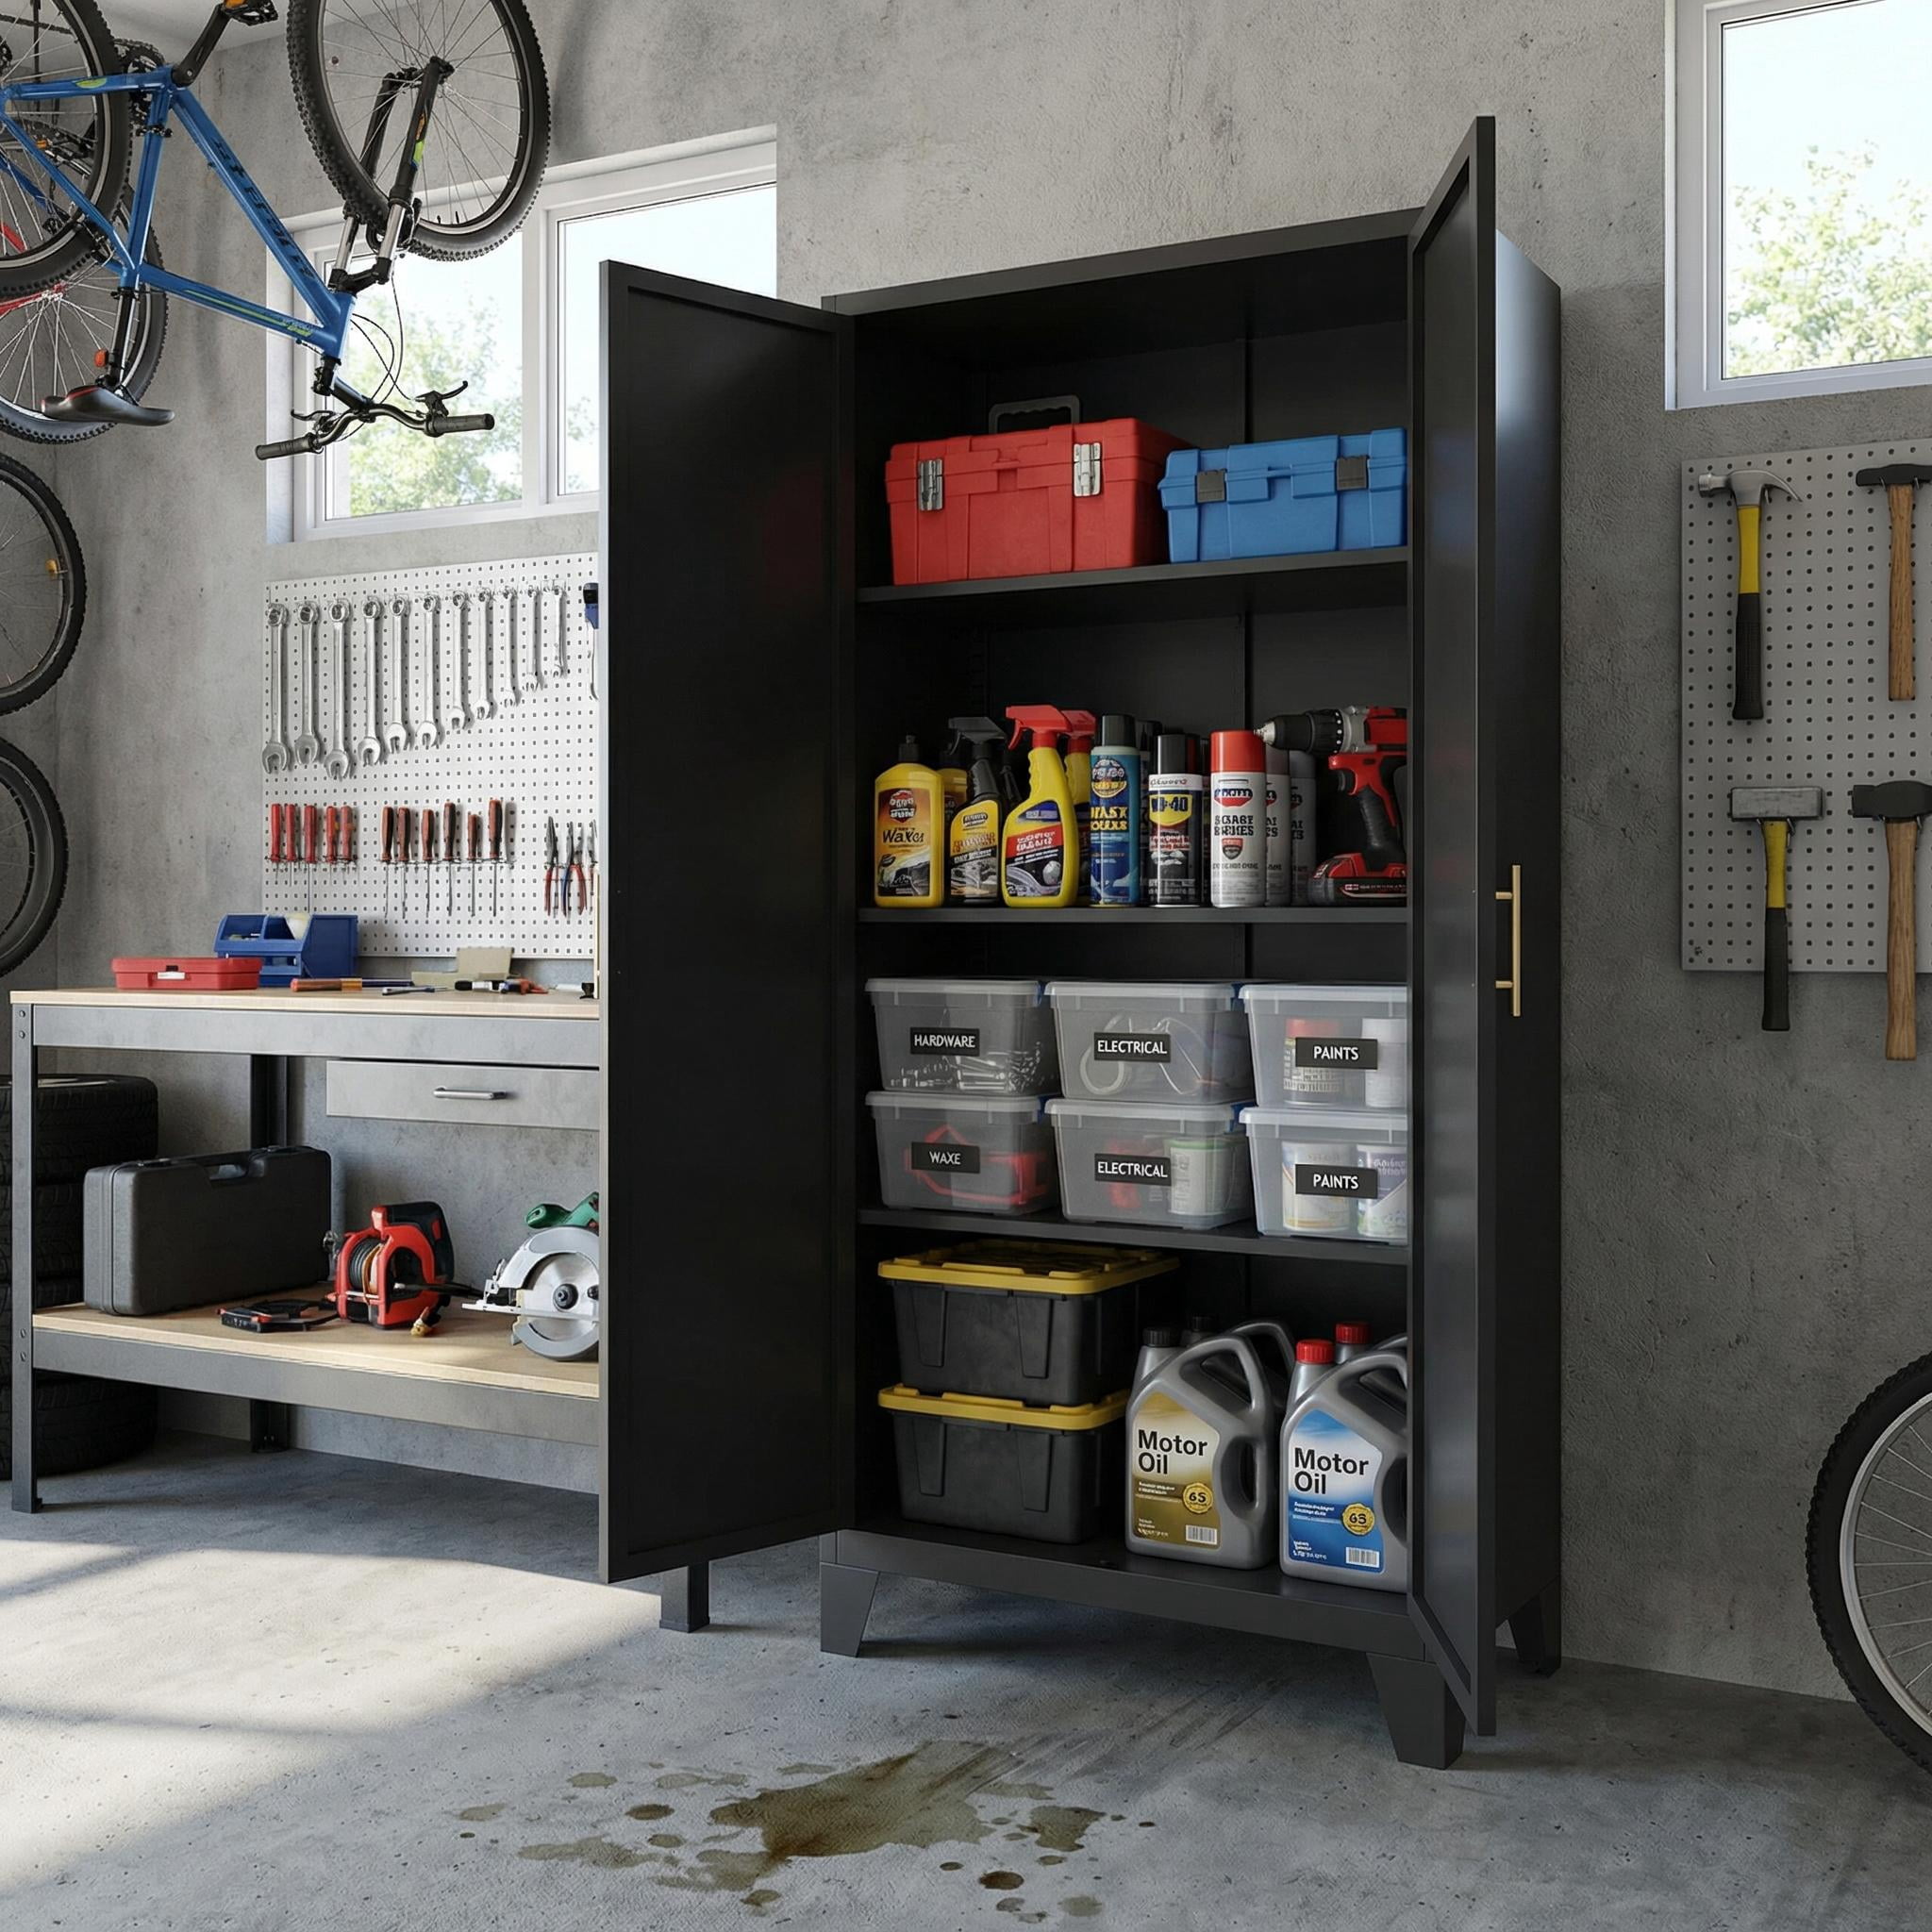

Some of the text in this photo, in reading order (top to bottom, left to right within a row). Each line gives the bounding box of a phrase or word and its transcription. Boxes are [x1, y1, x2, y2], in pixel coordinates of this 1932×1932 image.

[914, 1034, 976, 1049] HARDWARE
[1097, 1040, 1168, 1055] ELECTRICAL
[1313, 1045, 1359, 1061] PAINTS
[929, 1151, 961, 1165] WAXE
[1097, 1161, 1168, 1177] ELECTRICAL
[1313, 1174, 1359, 1190] PAINTS
[1138, 1428, 1208, 1457] Motor
[1138, 1452, 1168, 1474] Oil
[1294, 1447, 1370, 1475] Motor
[1294, 1471, 1326, 1494] Oil
